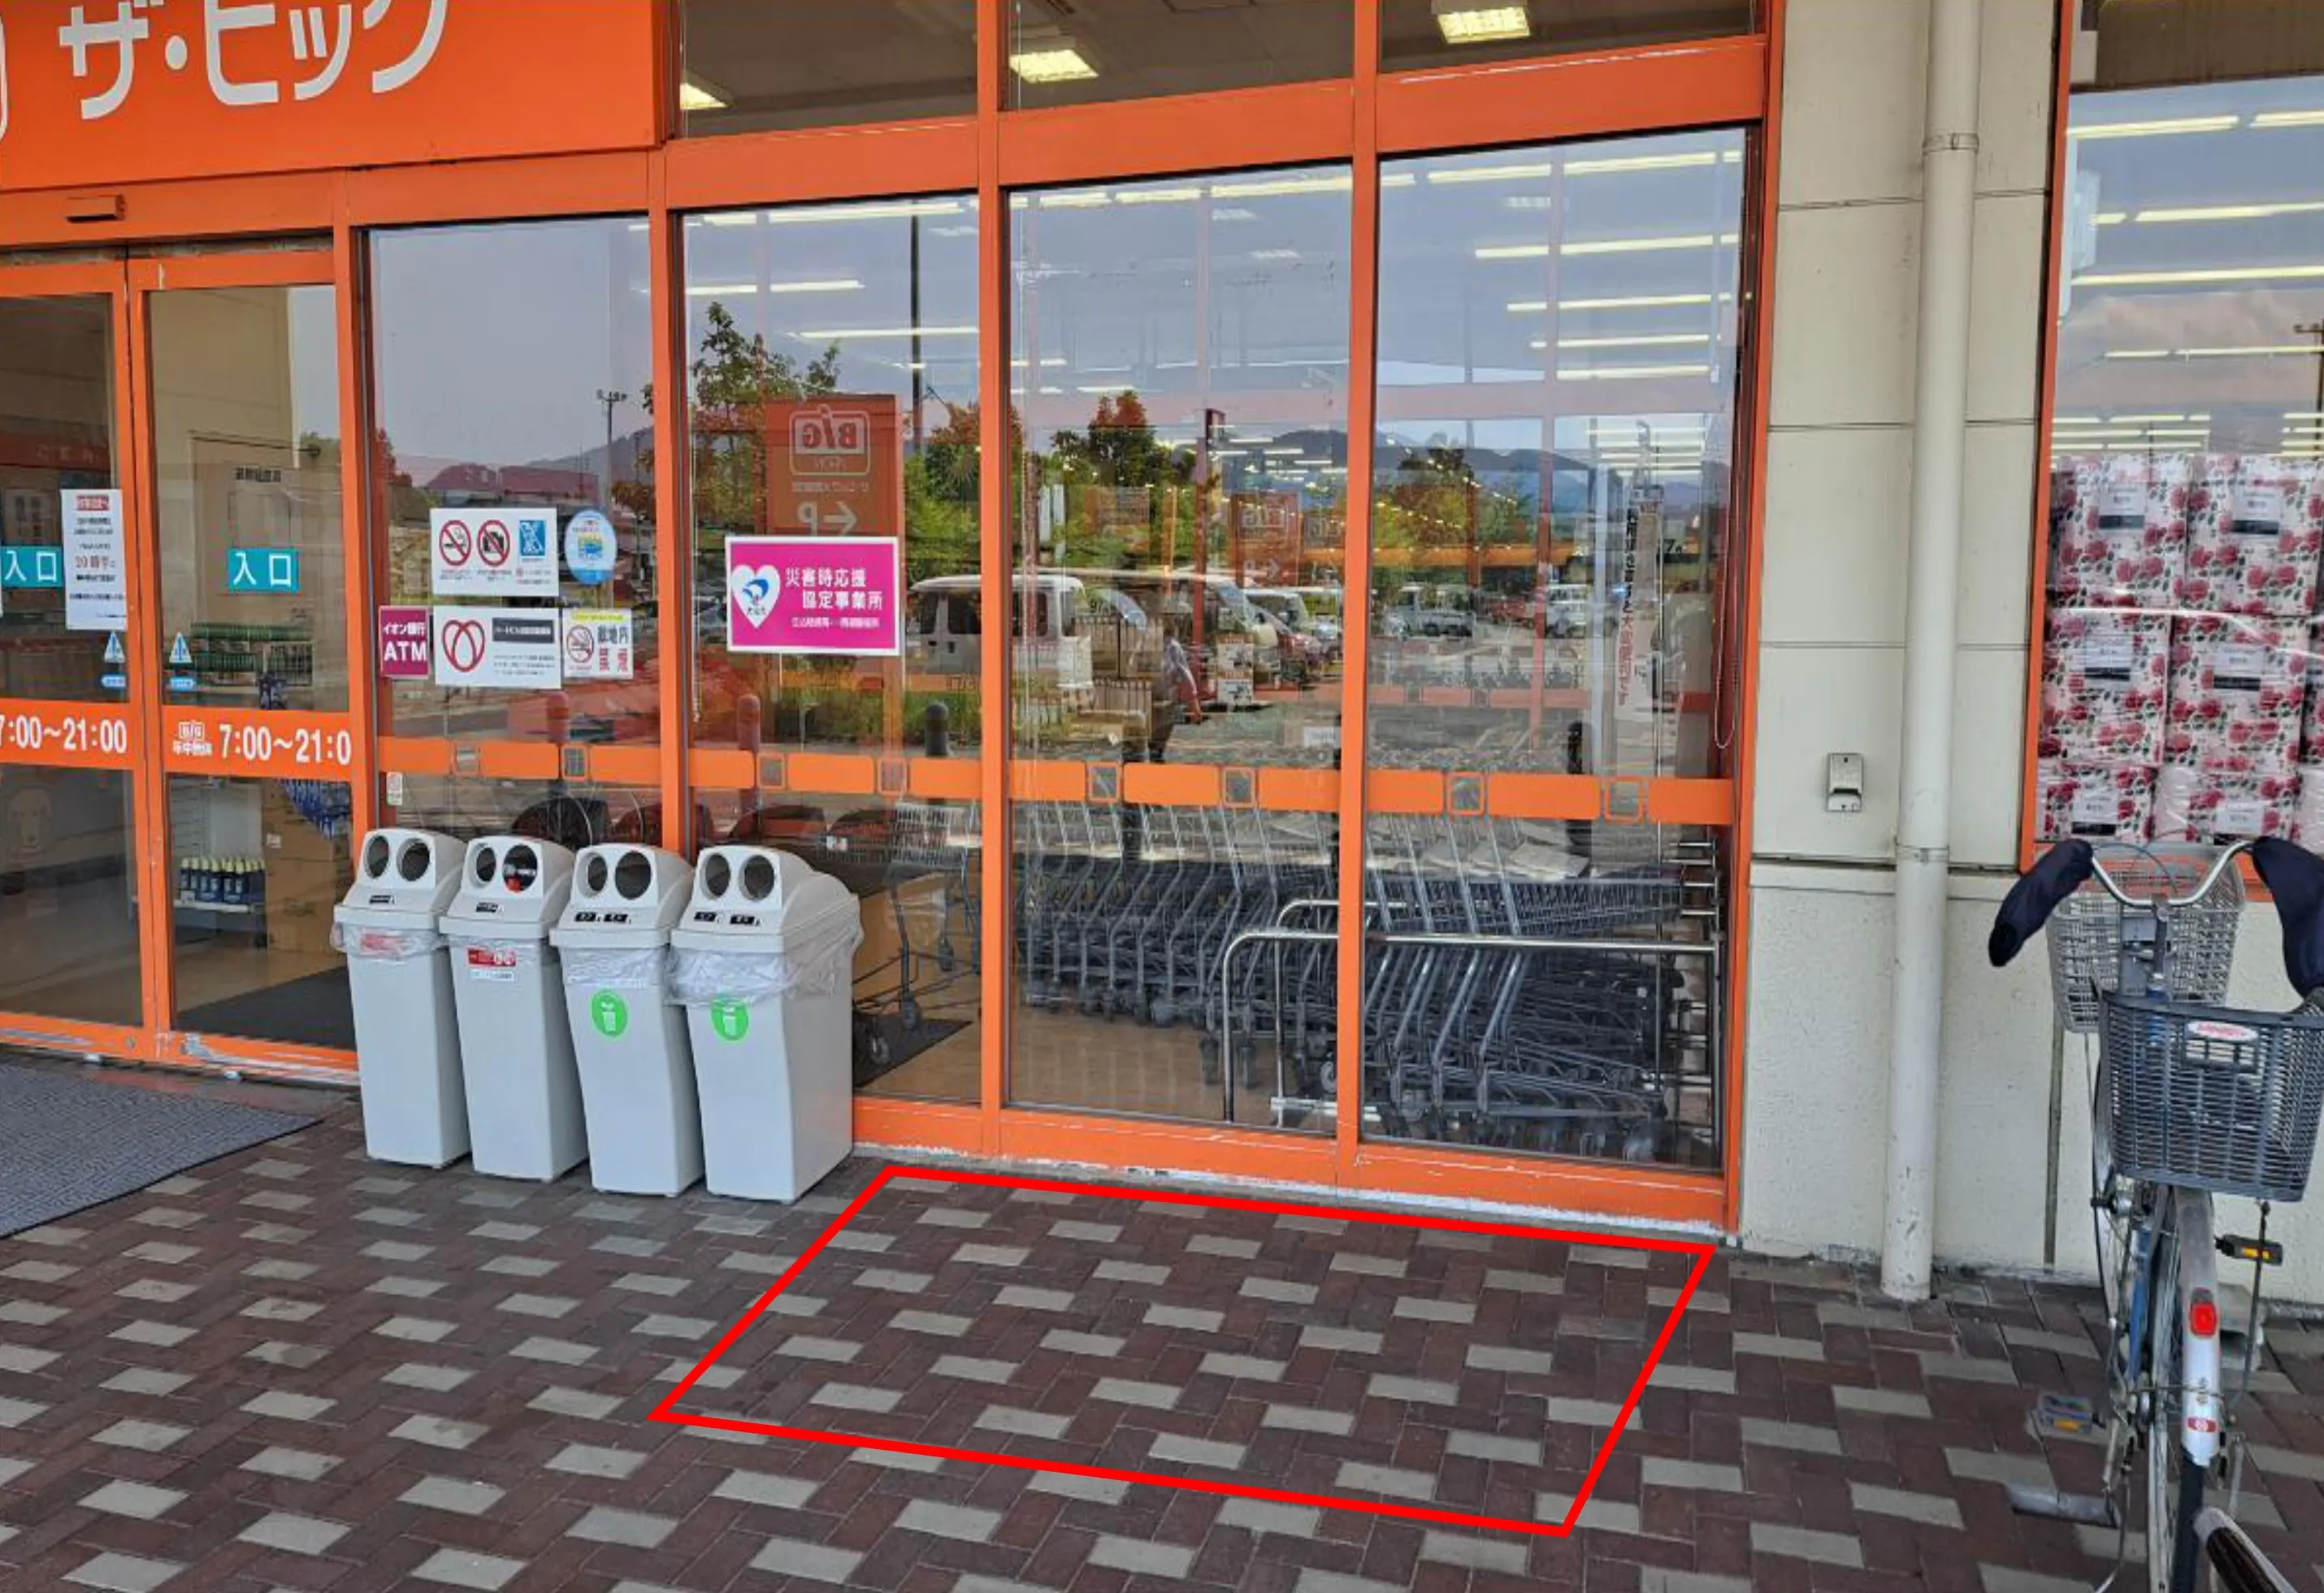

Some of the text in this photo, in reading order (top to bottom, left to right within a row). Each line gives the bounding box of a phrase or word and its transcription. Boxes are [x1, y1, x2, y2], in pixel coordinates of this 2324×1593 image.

[5, 549, 57, 583] 入口
[232, 552, 293, 587] 入口
[383, 621, 426, 635] イオン銀行
[384, 641, 427, 662] ATM
